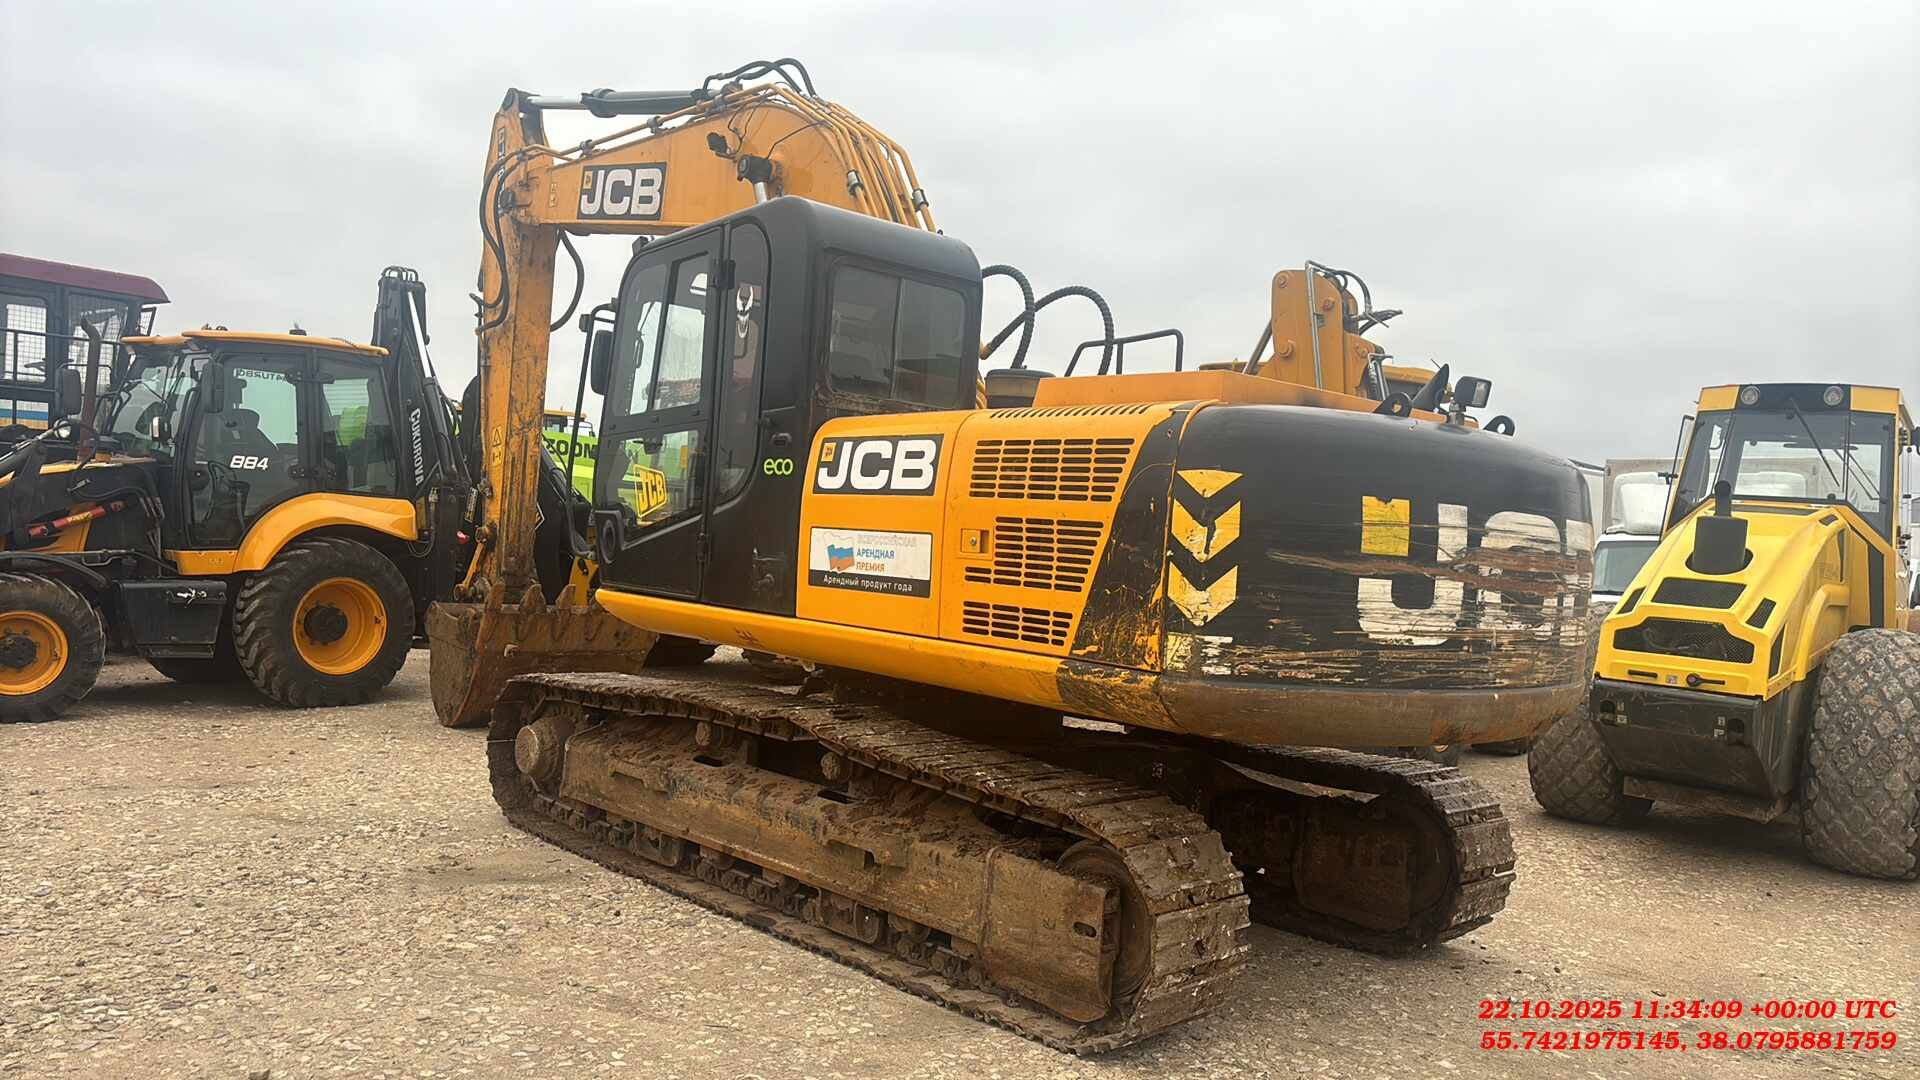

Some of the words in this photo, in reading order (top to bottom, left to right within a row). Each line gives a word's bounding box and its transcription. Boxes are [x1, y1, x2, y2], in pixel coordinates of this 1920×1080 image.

[580, 167, 663, 215] JCB
[230, 455, 269, 470] 884
[763, 458, 793, 476] eco
[817, 439, 937, 490] JCB
[637, 470, 665, 513] JCB
[856, 548, 895, 560] АРЕНДНАЯ
[856, 561, 885, 573] ПРЕМИЯ
[823, 574, 860, 587] Арендный
[861, 579, 892, 591] продукт
[893, 582, 913, 592] года
